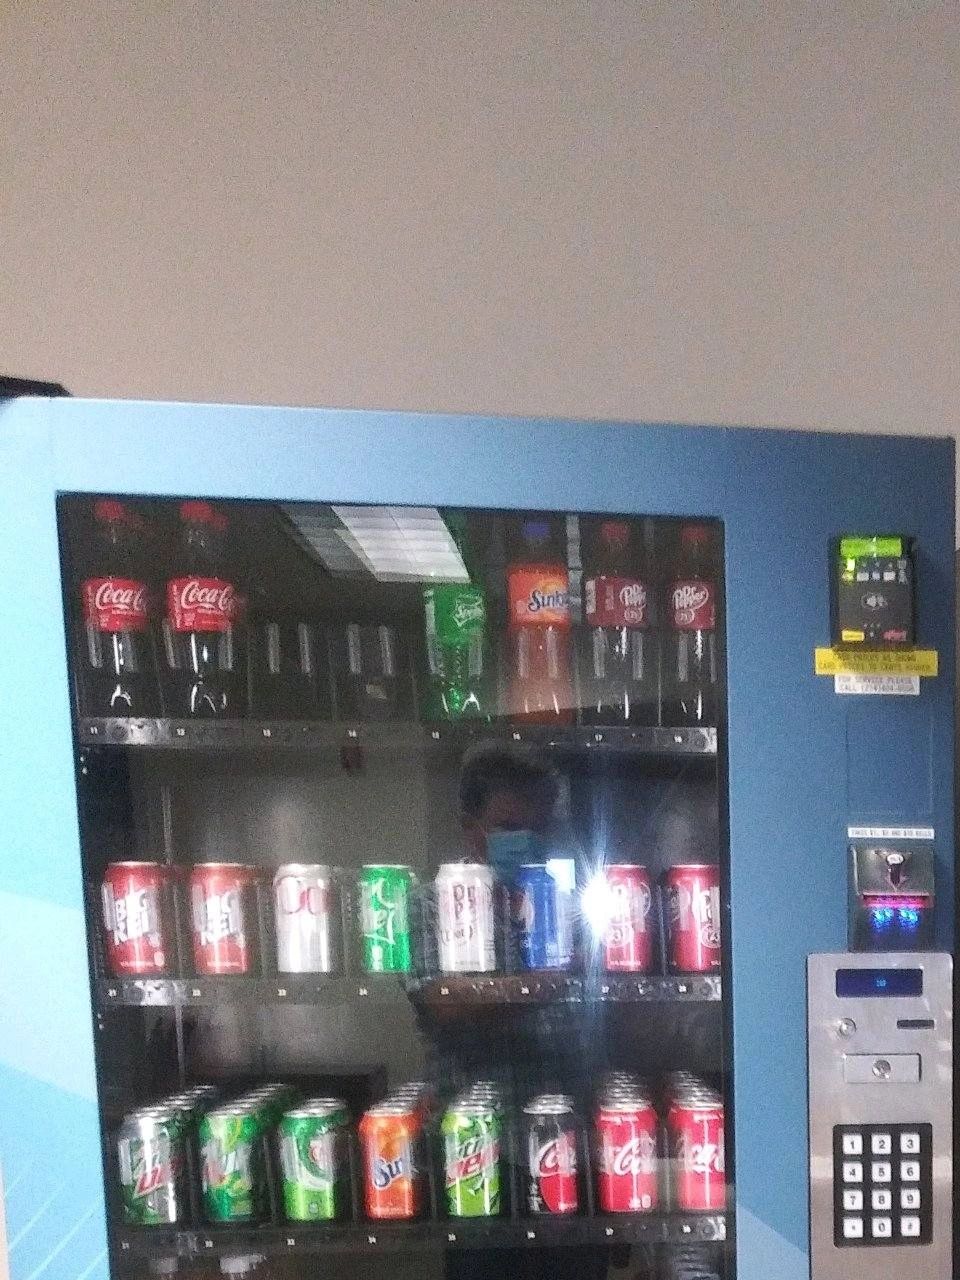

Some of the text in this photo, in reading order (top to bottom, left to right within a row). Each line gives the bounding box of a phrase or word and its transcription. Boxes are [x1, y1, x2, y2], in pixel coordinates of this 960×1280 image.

[849, 1139, 915, 1150] 1 2 3
[849, 1166, 915, 1178] 4 5 6
[849, 1194, 915, 1206] 7 8 9
[878, 1222, 886, 1233] 0
